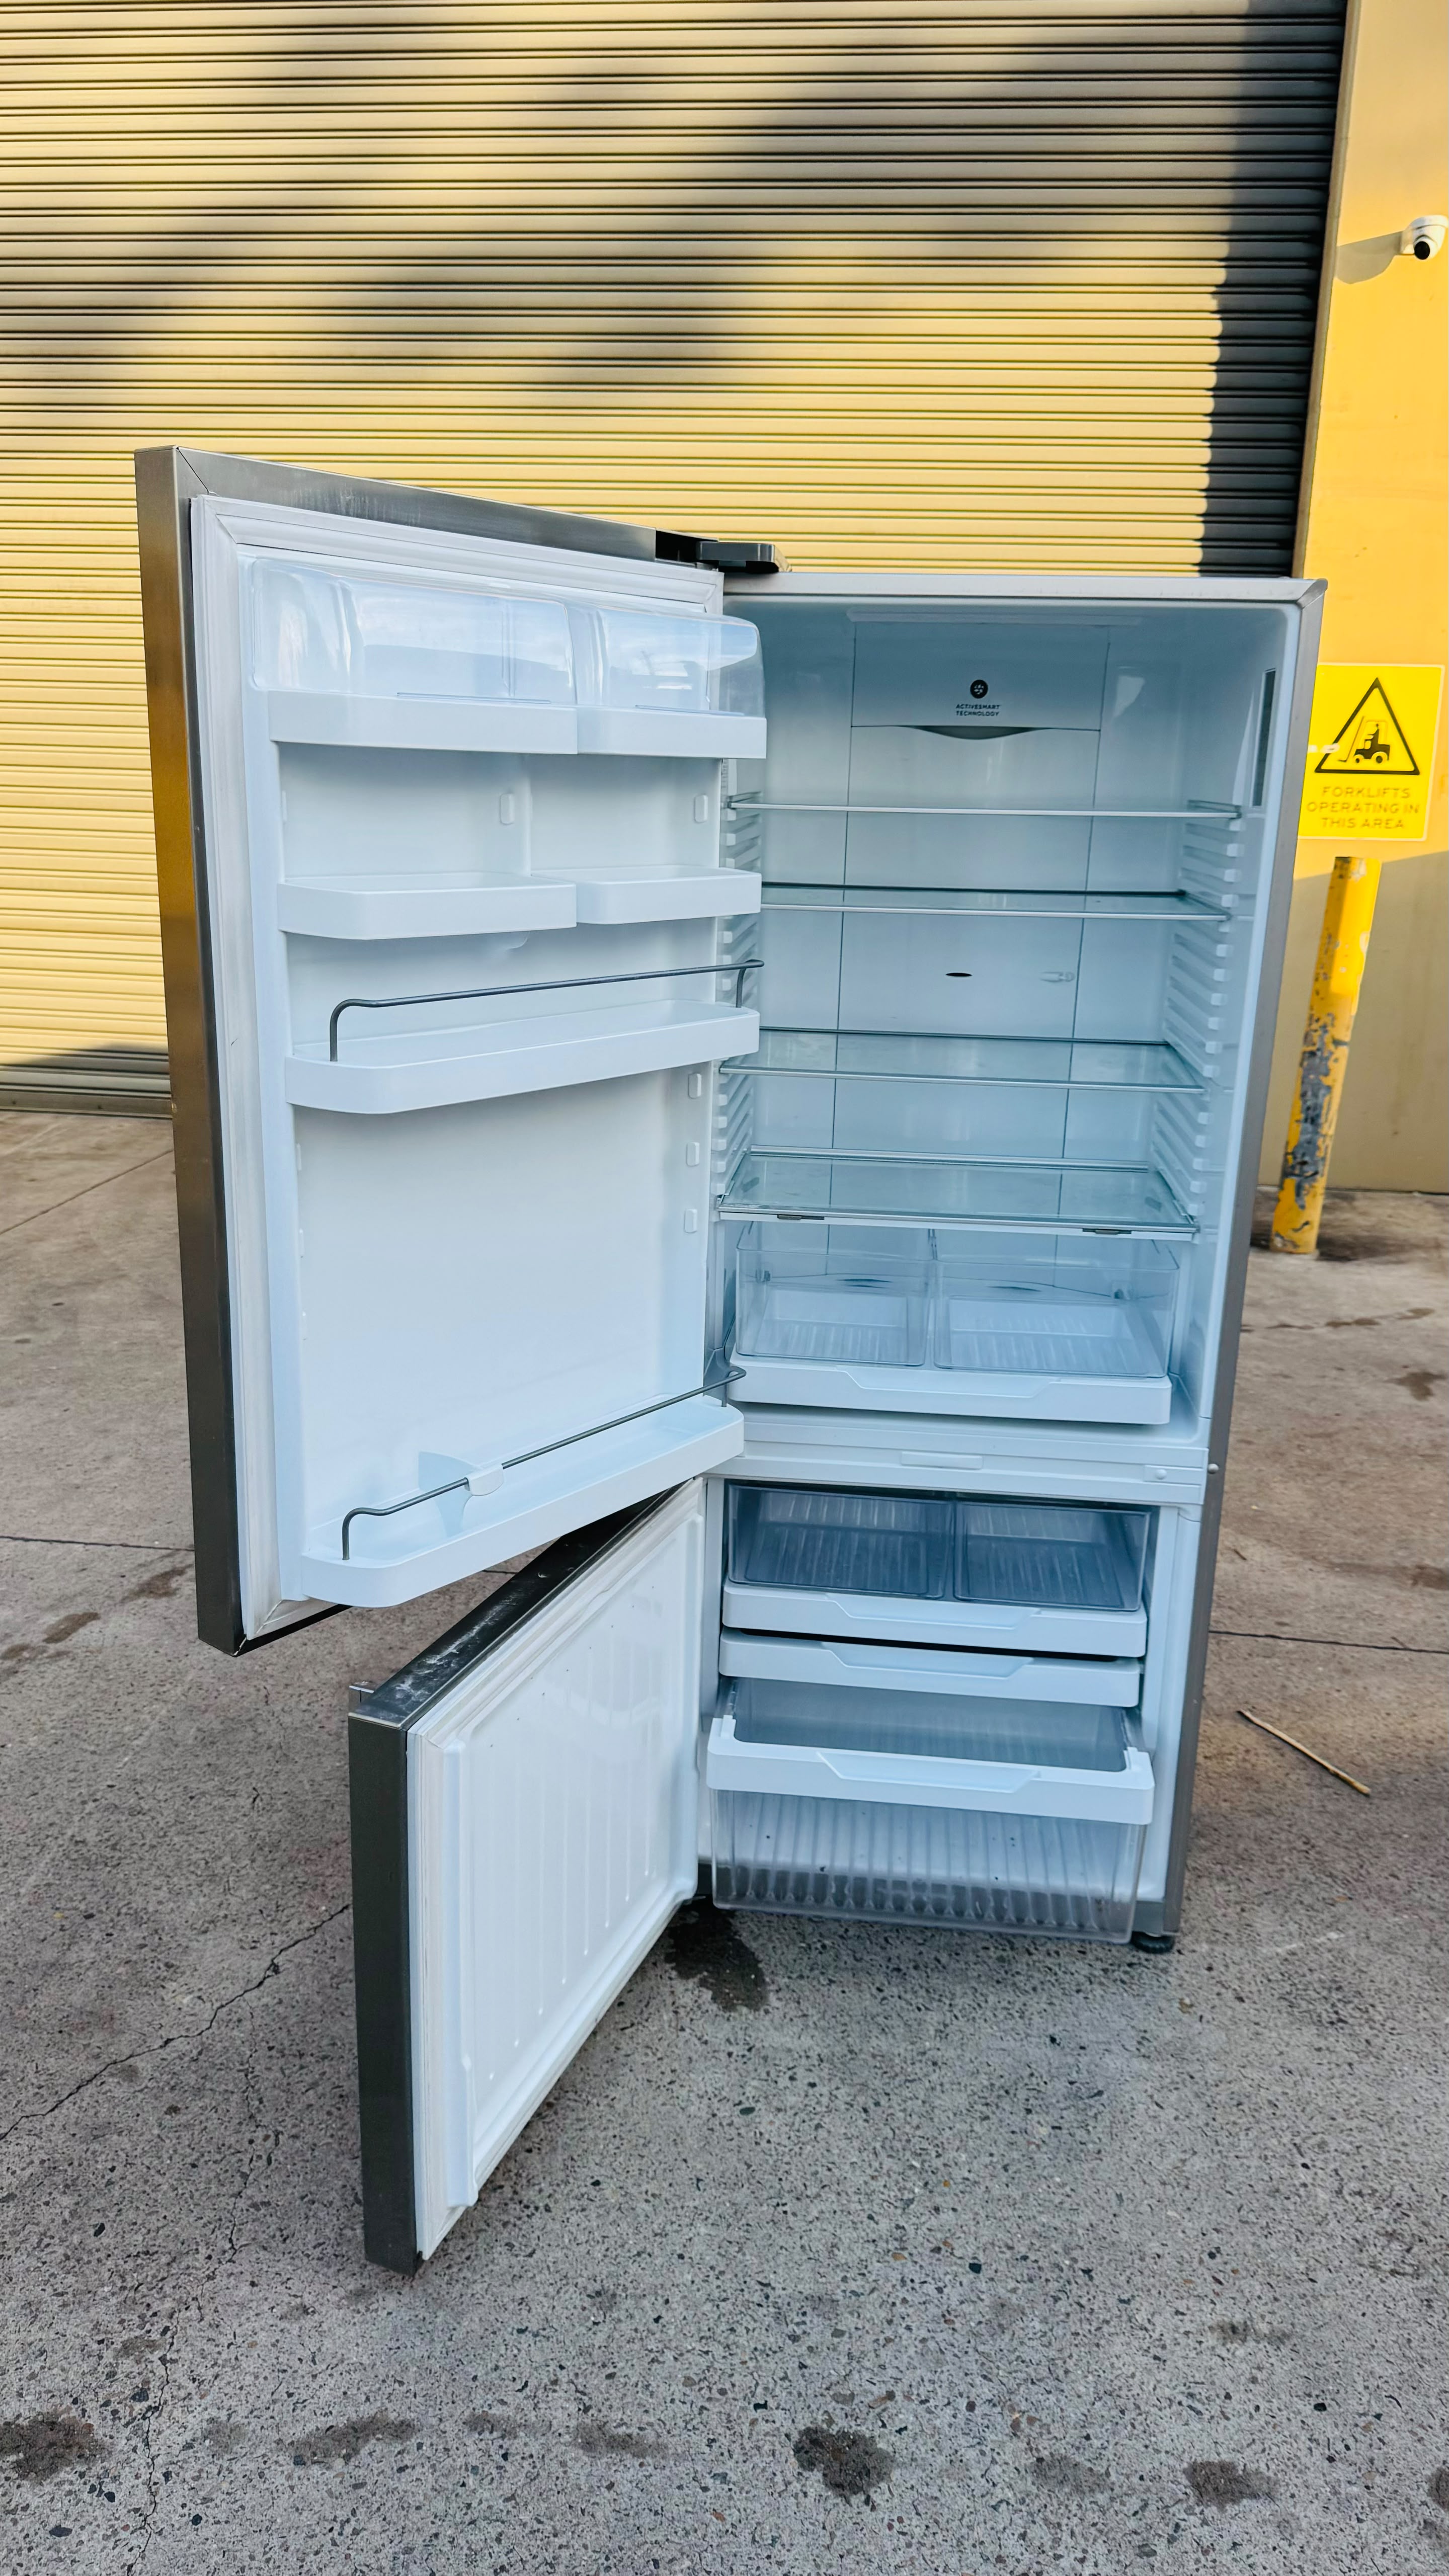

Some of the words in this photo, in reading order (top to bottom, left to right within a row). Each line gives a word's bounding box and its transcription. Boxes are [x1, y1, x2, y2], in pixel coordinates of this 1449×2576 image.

[1322, 786, 1410, 798] FORKLIFTS
[1307, 801, 1399, 813] OPERATING
[1403, 803, 1419, 814] IN
[1322, 818, 1356, 828] THIS
[1360, 818, 1404, 829] AREA
